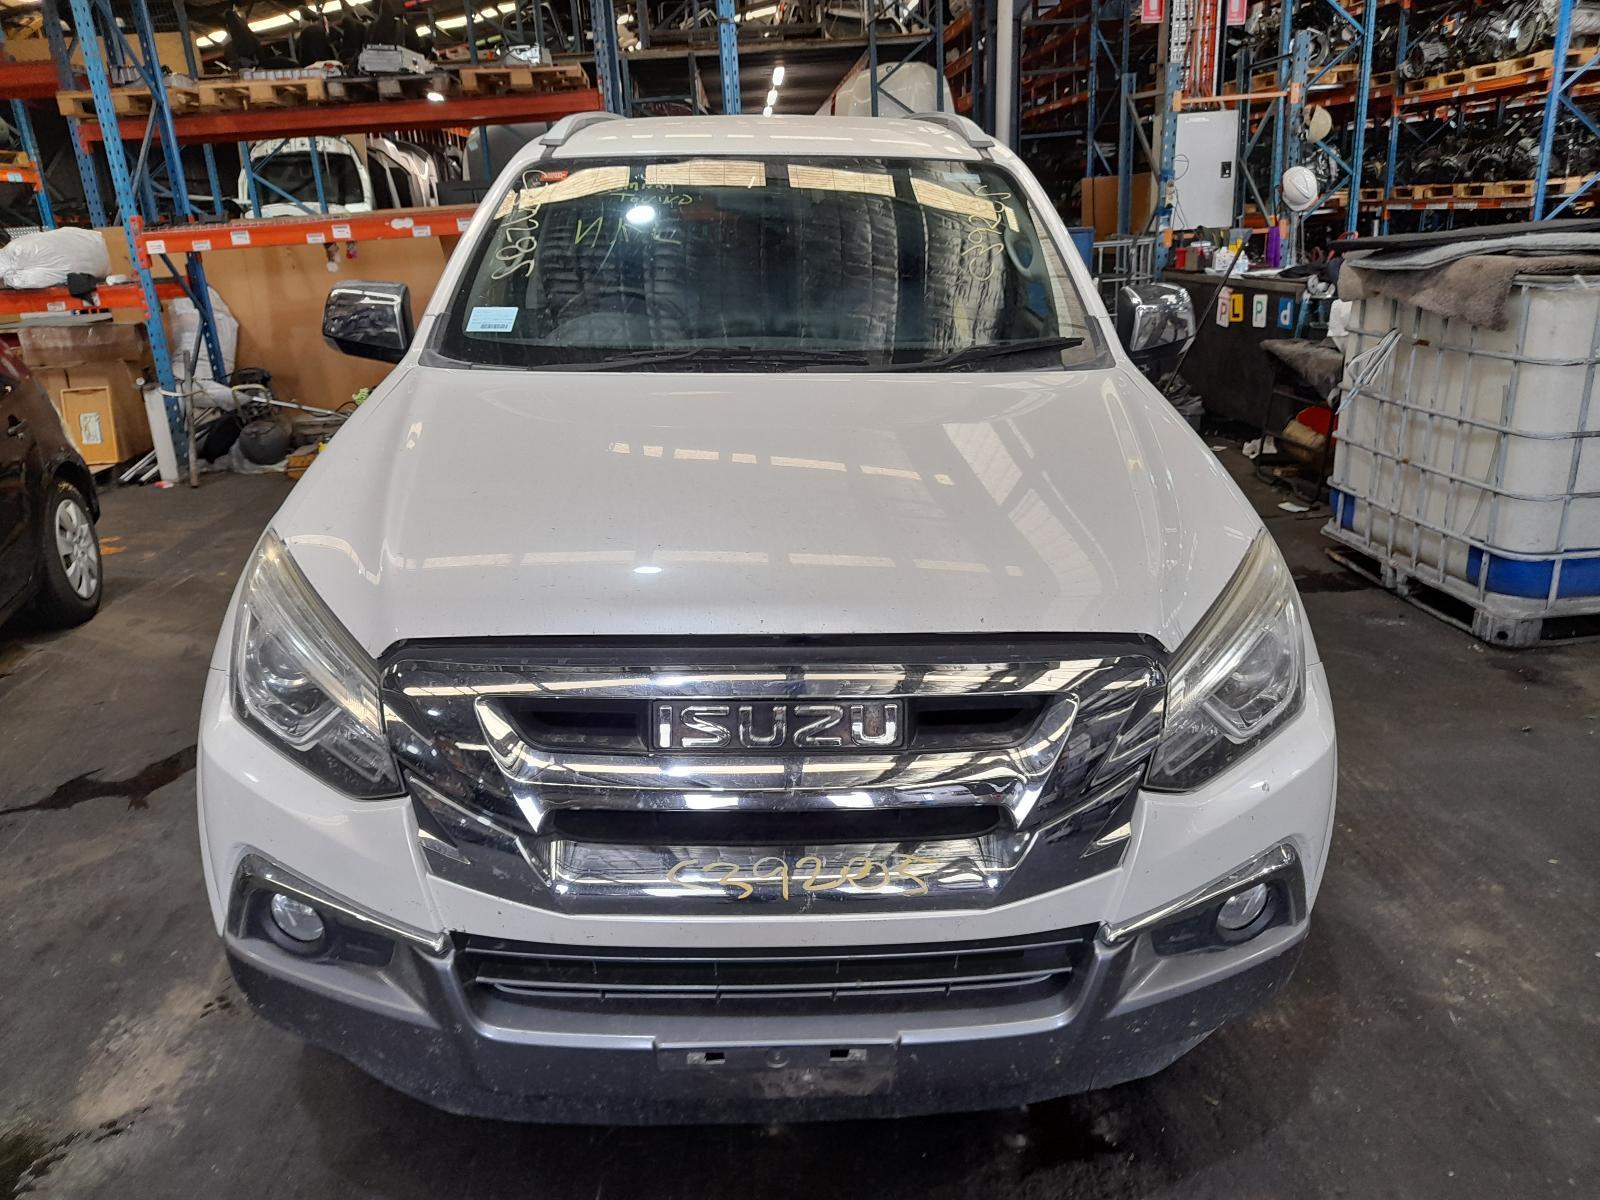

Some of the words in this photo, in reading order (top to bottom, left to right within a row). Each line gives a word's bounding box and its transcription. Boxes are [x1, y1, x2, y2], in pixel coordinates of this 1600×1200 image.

[1232, 298, 1241, 318] L
[1255, 300, 1264, 321] P
[658, 703, 898, 747] ISUZU
